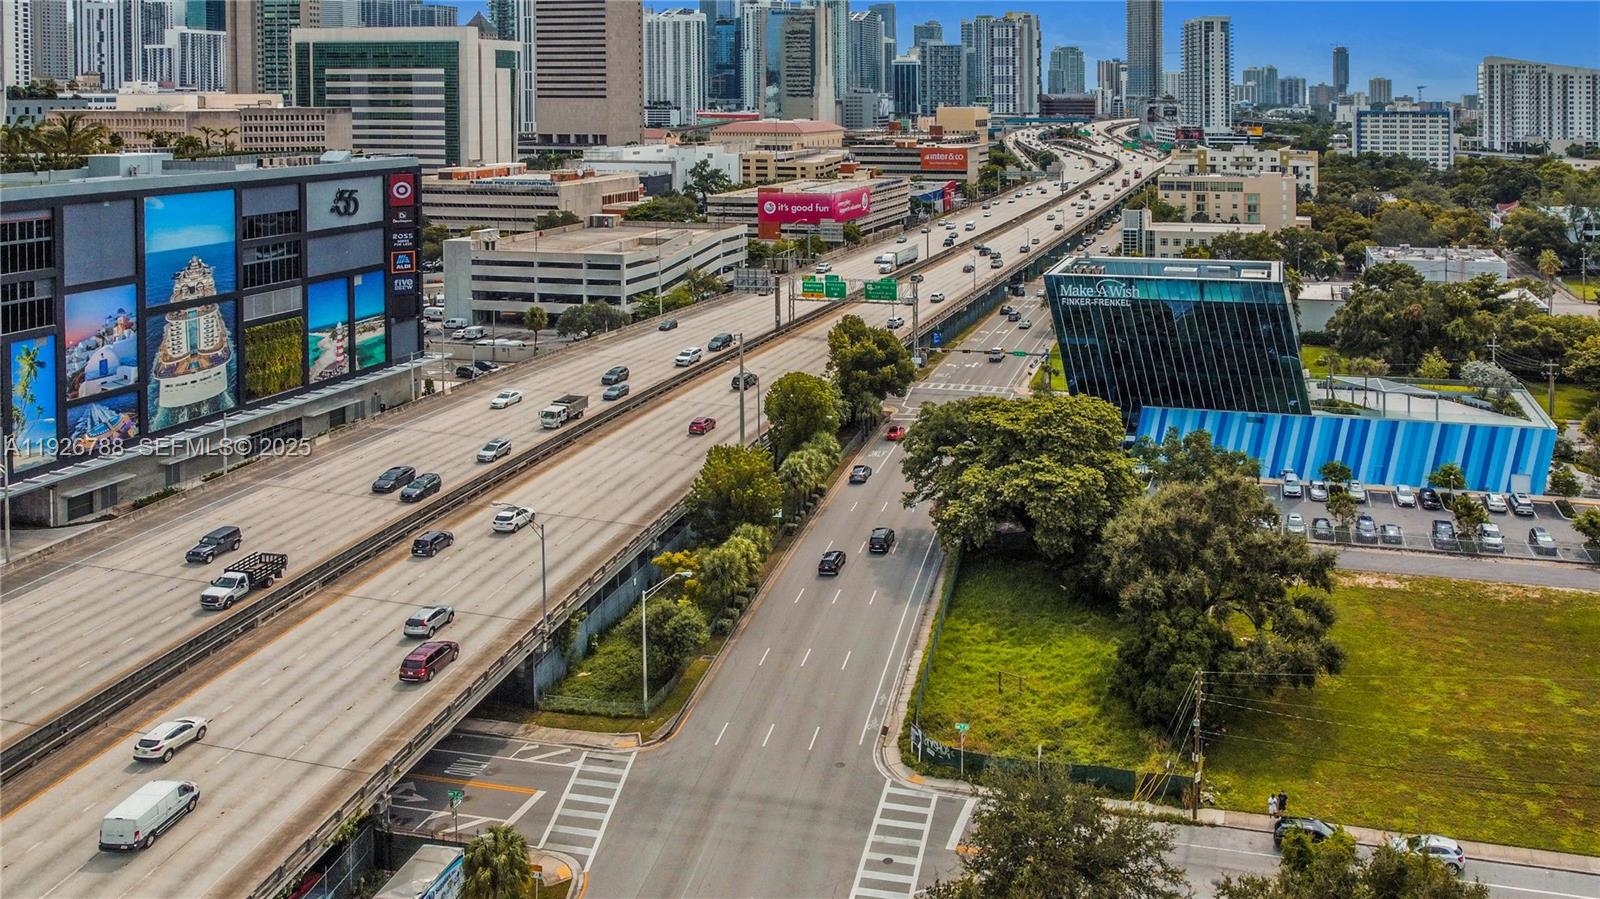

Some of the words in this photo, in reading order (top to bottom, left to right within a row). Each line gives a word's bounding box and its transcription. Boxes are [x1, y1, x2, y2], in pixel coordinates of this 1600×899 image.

[777, 203, 789, 211] it's
[791, 203, 813, 213] good
[815, 203, 830, 212] fun
[1061, 298, 1132, 307] FINKER-FRENKEL
